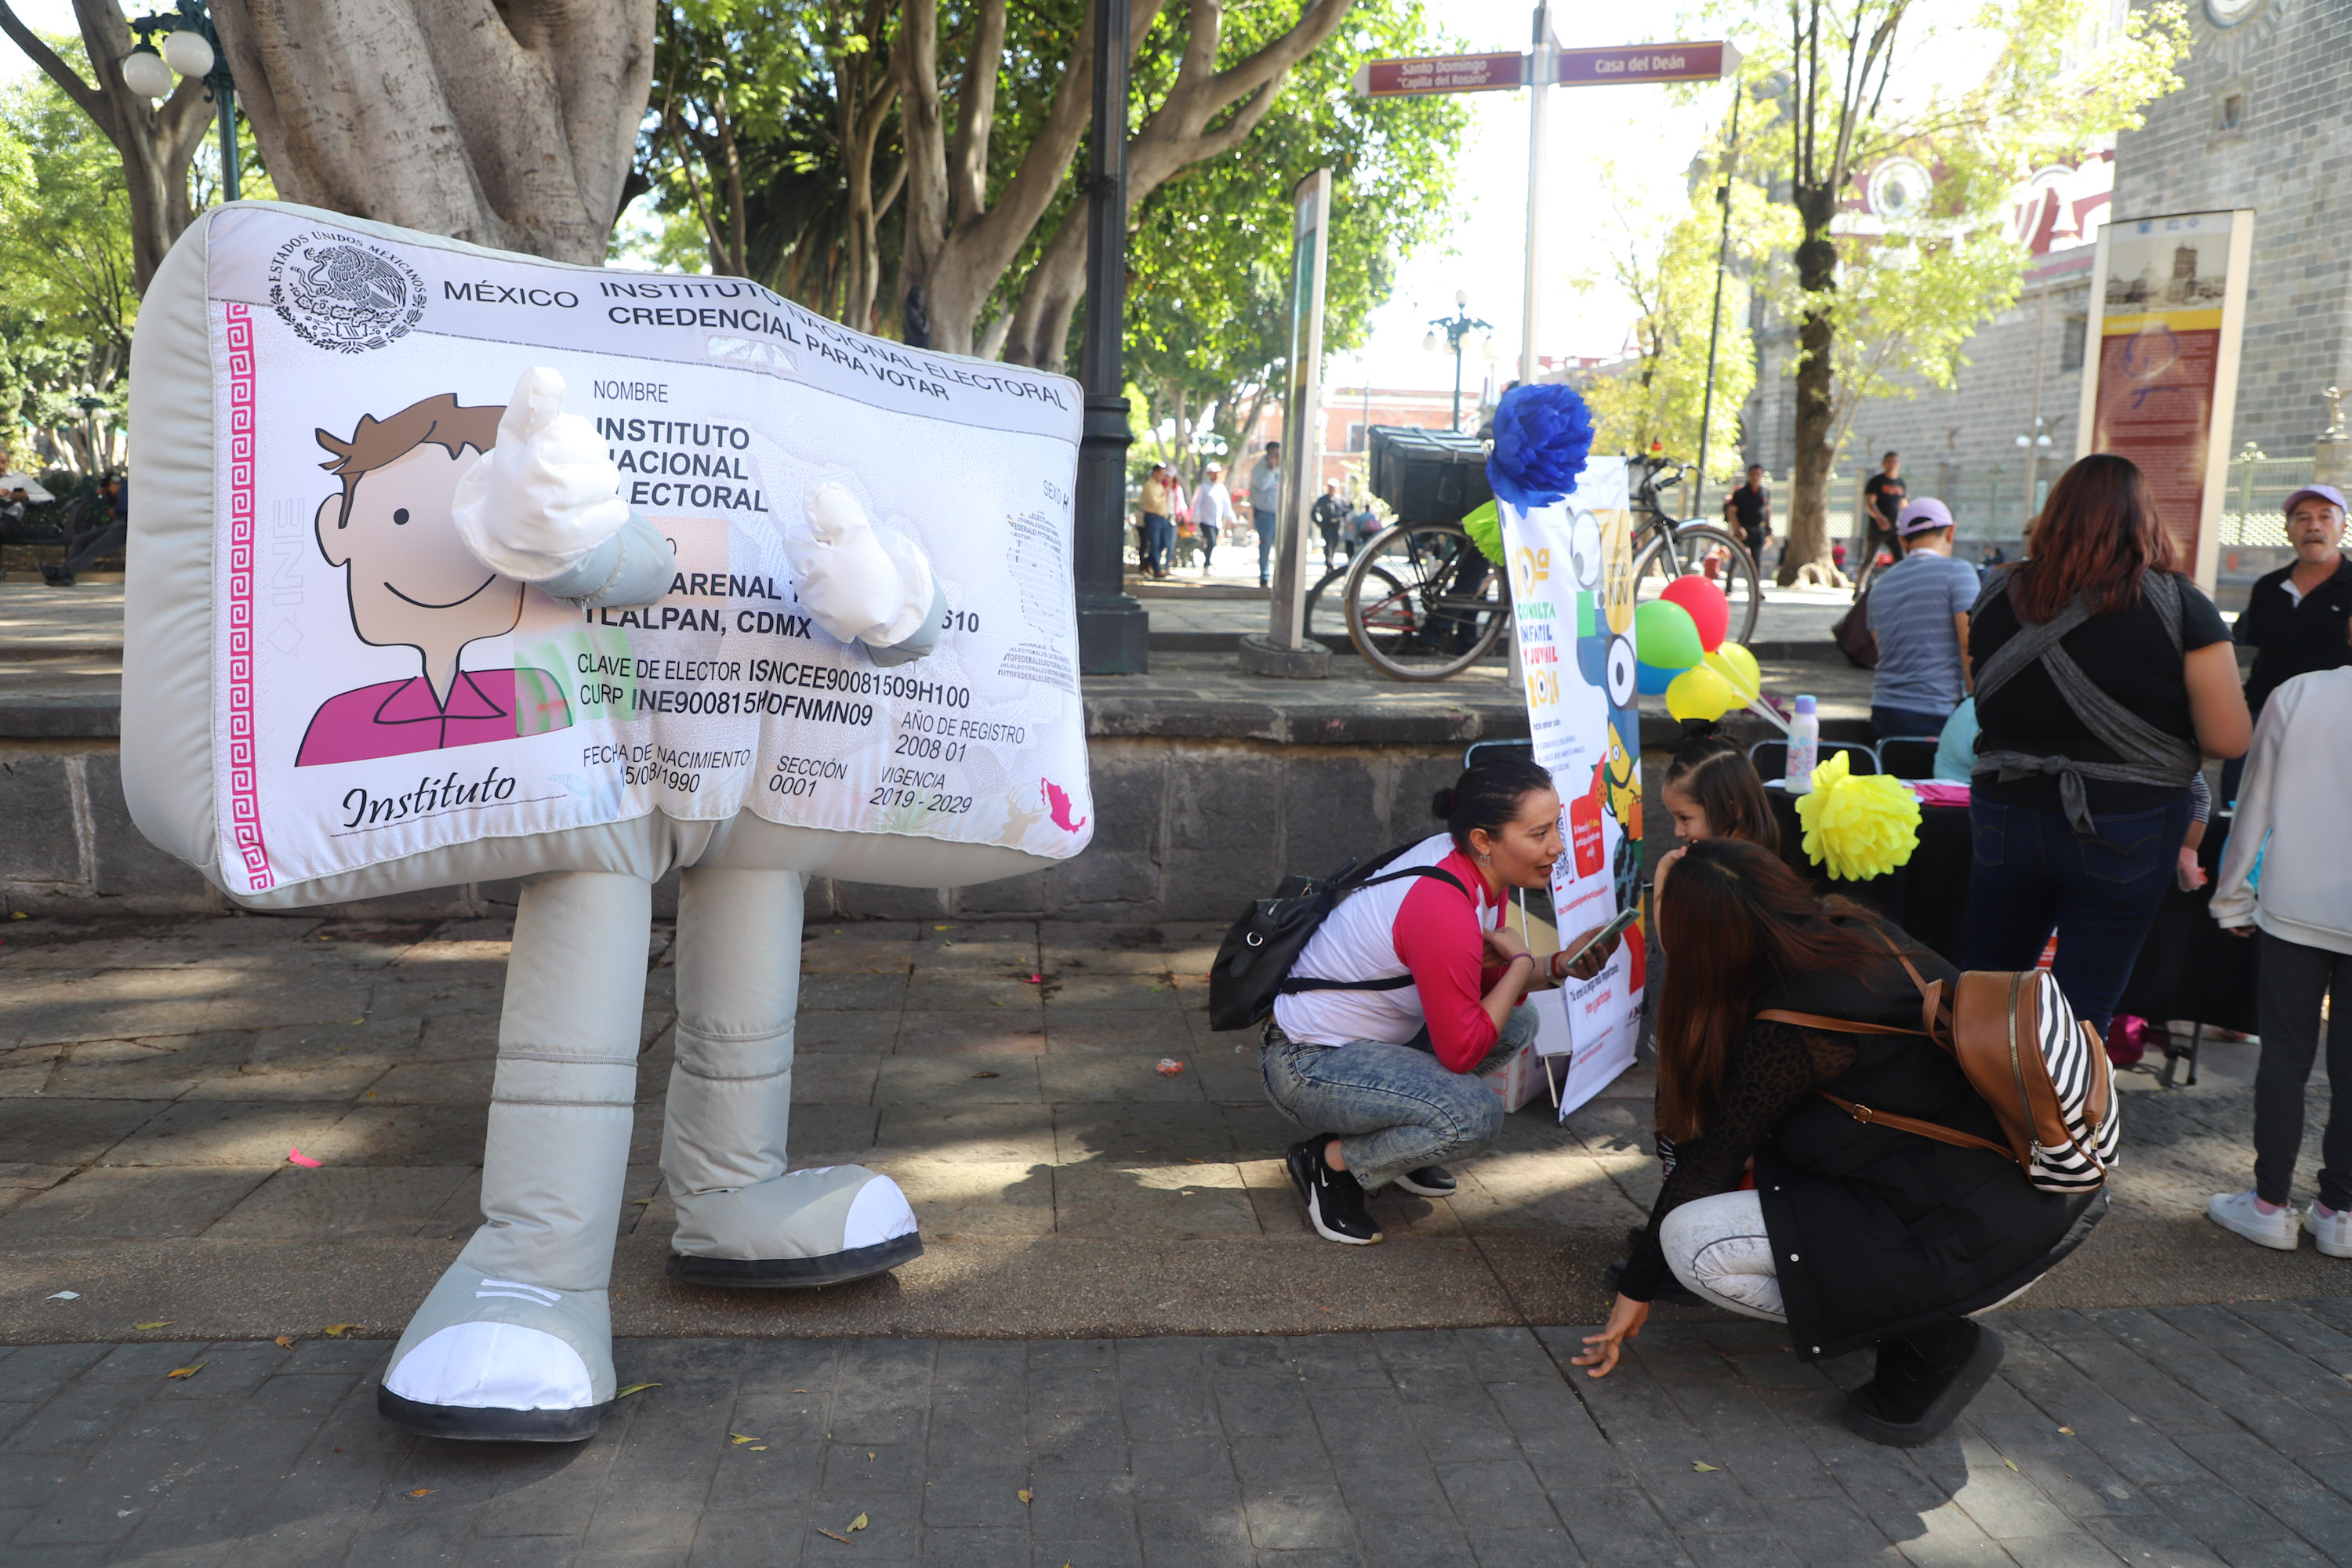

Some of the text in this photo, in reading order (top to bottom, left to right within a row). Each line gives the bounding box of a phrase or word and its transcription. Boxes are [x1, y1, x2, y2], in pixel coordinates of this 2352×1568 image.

[1401, 58, 1487, 76] Santo Domingo
[1595, 53, 1686, 73] Casa del Deán
[1435, 74, 1450, 87] del
[269, 231, 426, 293] ESTADOS UNIDOS MEXICANOS
[444, 280, 579, 308] MÉXICO
[600, 282, 781, 307] INSTITUTO
[785, 303, 924, 372] NACIONAL
[924, 361, 1069, 412] ELECTORAL
[608, 307, 801, 345] CREDENCIAL
[805, 332, 868, 376] PARA
[870, 363, 950, 401] VOTAR
[594, 380, 668, 403] NOMBRE
[597, 417, 750, 450] INSTITUTO
[616, 481, 769, 513] ECTORAL
[1043, 480, 1069, 514] SEXO H
[272, 497, 305, 607] INE
[668, 572, 782, 600] ARENAL
[737, 610, 812, 640] CDMX
[578, 653, 971, 710] CLAVE DE ELECTOR ISNCEE90081509H100
[580, 683, 623, 705] CURP
[902, 710, 1025, 744] AÑO DE REGISTRO
[583, 743, 751, 769] FECHA DE NACIMIENTO
[895, 734, 967, 763] 2008 01
[620, 762, 700, 793] 15/08/1990
[777, 756, 848, 780] SECCIÓN
[881, 765, 946, 789] VIGENCIA
[343, 766, 516, 829] Instituto
[769, 774, 818, 797] 0001
[869, 787, 915, 808] 2019
[927, 793, 974, 815] 2029
